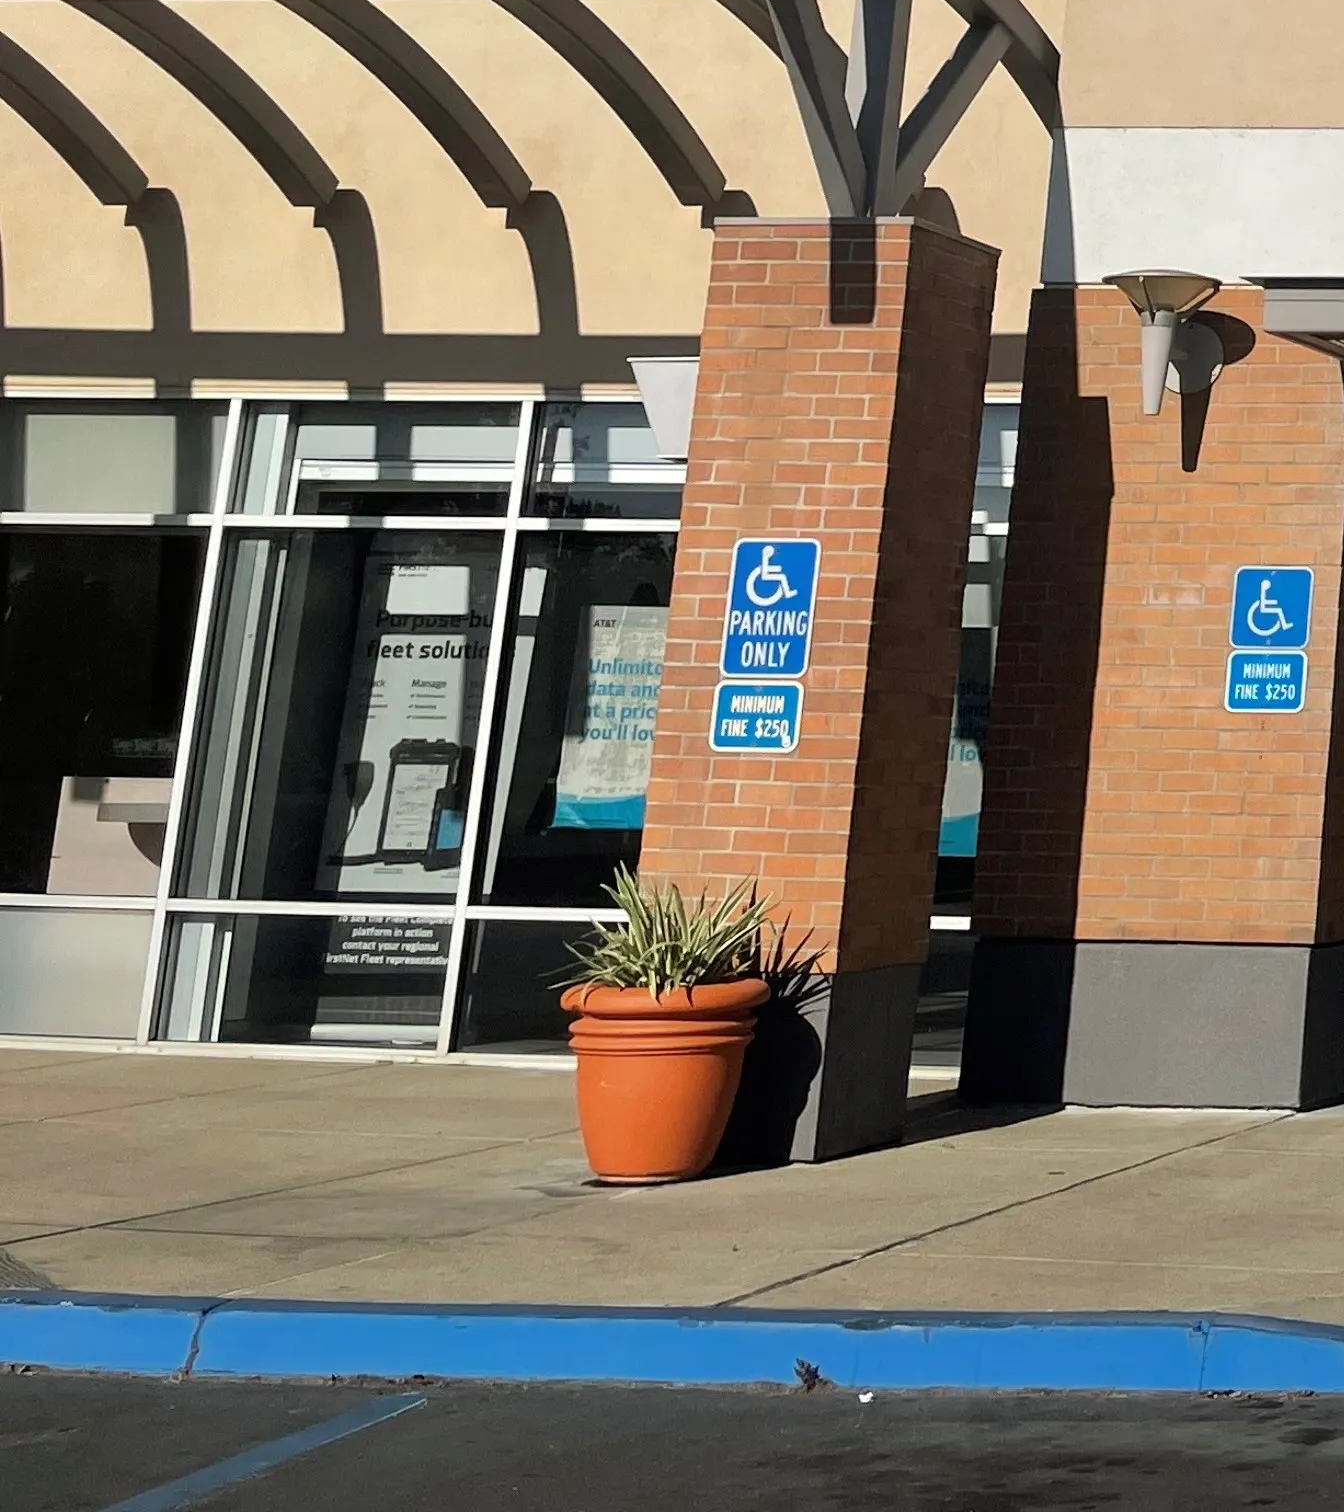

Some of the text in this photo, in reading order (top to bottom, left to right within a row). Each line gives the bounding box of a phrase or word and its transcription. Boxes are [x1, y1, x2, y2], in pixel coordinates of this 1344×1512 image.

[376, 609, 493, 631] Purpose-bu
[593, 619, 617, 628] AT&T
[729, 610, 809, 636] PARKING
[419, 640, 489, 659] solutio
[741, 641, 791, 667] ONLY
[1243, 663, 1291, 679] MINIMUM
[1235, 682, 1296, 701] FINE $250
[606, 706, 616, 718] a
[621, 703, 656, 722] pric
[730, 695, 785, 714] MINIMUM
[720, 717, 789, 738] FINE $250
[386, 955, 448, 966] representativ
